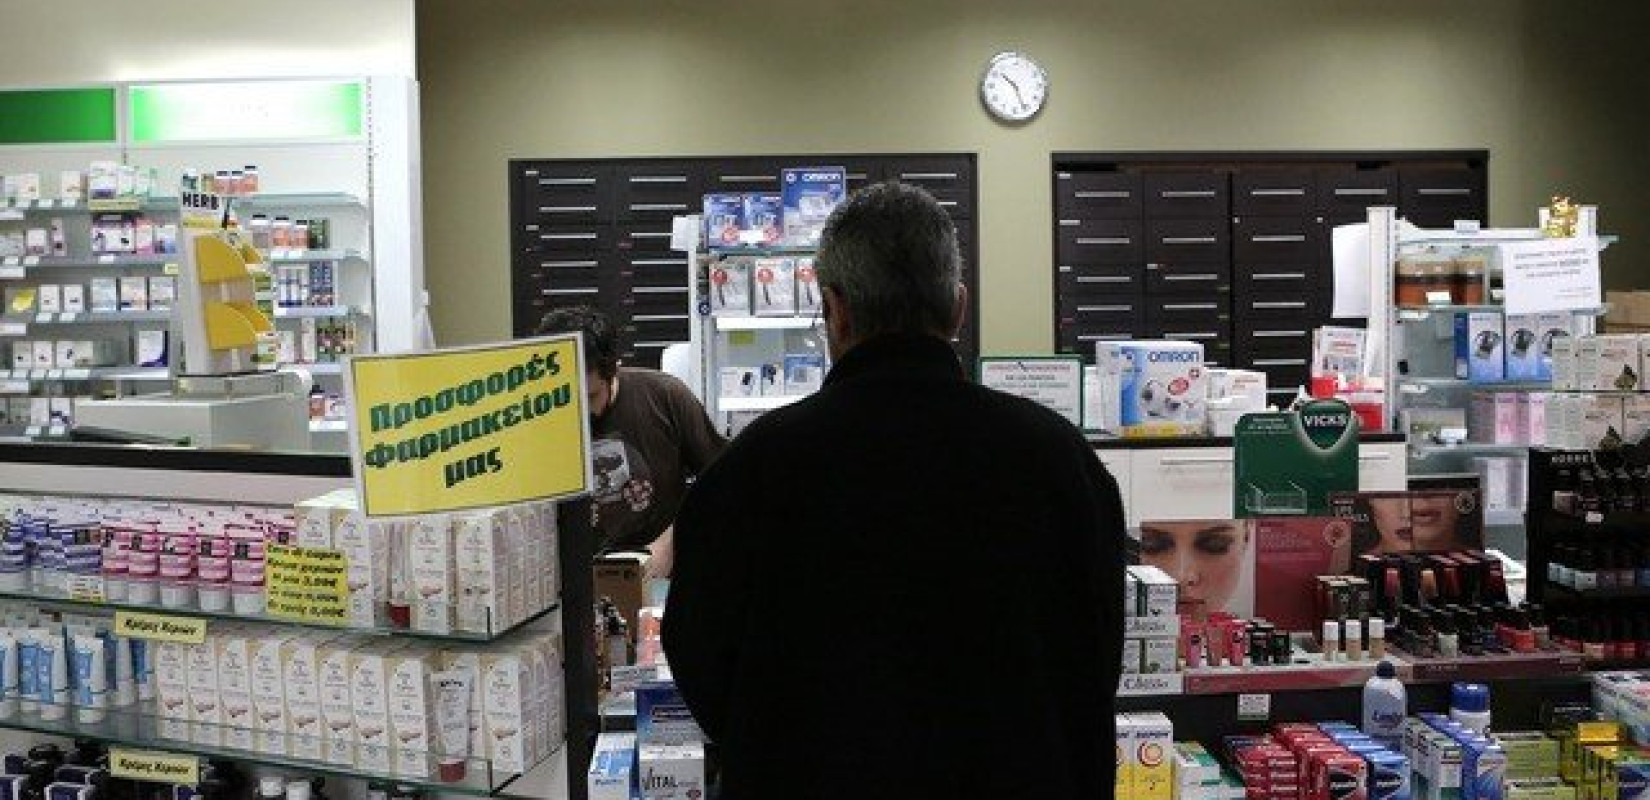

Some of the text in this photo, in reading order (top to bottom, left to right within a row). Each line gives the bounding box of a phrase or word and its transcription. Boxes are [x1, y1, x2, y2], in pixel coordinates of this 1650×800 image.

[802, 173, 841, 182] OMRON
[1148, 351, 1199, 364] OMRON
[371, 351, 560, 432] Προσφορές
[1304, 414, 1346, 427] VICKS
[445, 447, 502, 488] μας
[641, 766, 679, 790] VITAL
